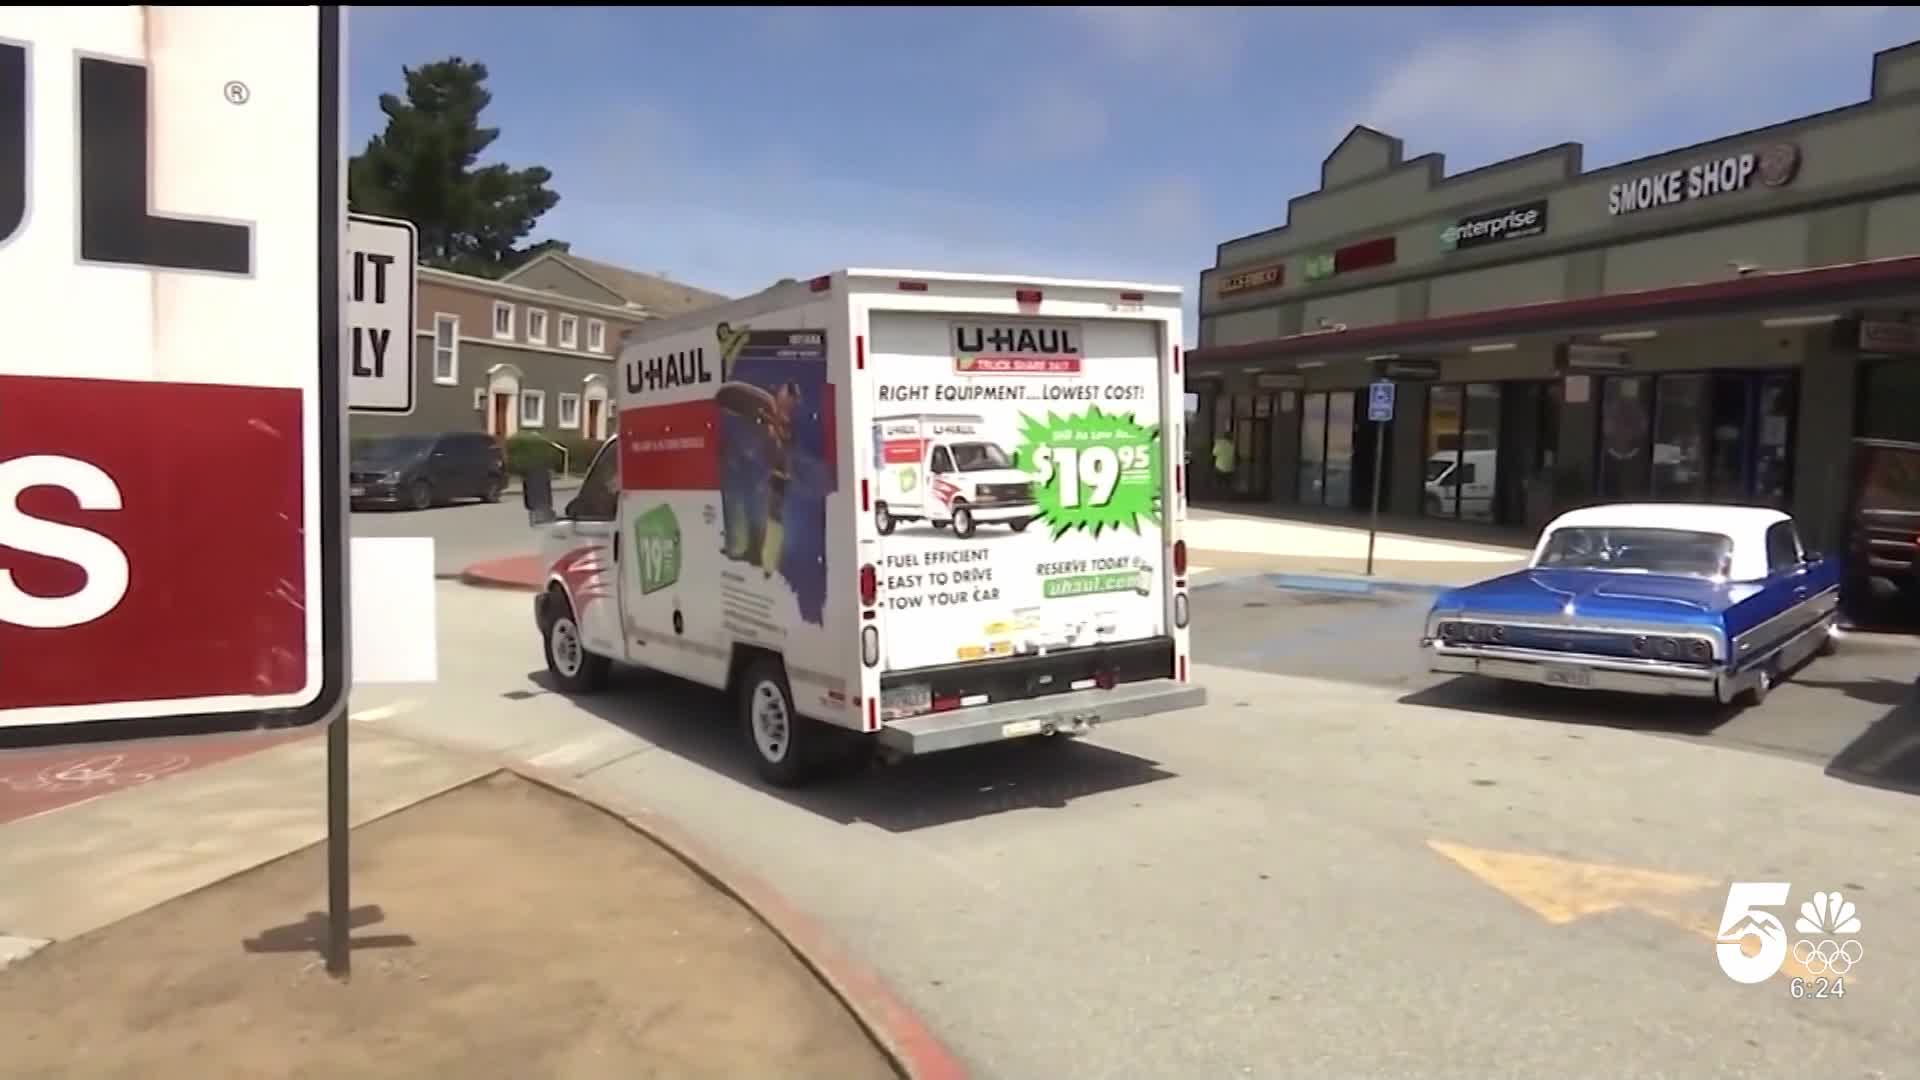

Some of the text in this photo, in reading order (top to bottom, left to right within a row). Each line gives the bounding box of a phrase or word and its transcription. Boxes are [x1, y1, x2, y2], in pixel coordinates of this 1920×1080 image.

[0, 40, 256, 278] L
[1608, 153, 1754, 215] SMOKE SHOP
[1440, 209, 1538, 243] enterprise
[347, 251, 395, 304] IT
[347, 327, 391, 377] LY
[957, 327, 1078, 354] U-HAUL
[626, 348, 712, 393] U-HAUL
[879, 384, 929, 400] RIGHT
[1104, 386, 1145, 400] COST!
[887, 548, 989, 568] FUEL EFFICIENT
[1036, 559, 1087, 576] RESERVE
[1091, 556, 1130, 572] TODAY
[887, 567, 993, 590] EASY TO DRIVE
[887, 587, 1000, 610] TOW YOUR CAR
